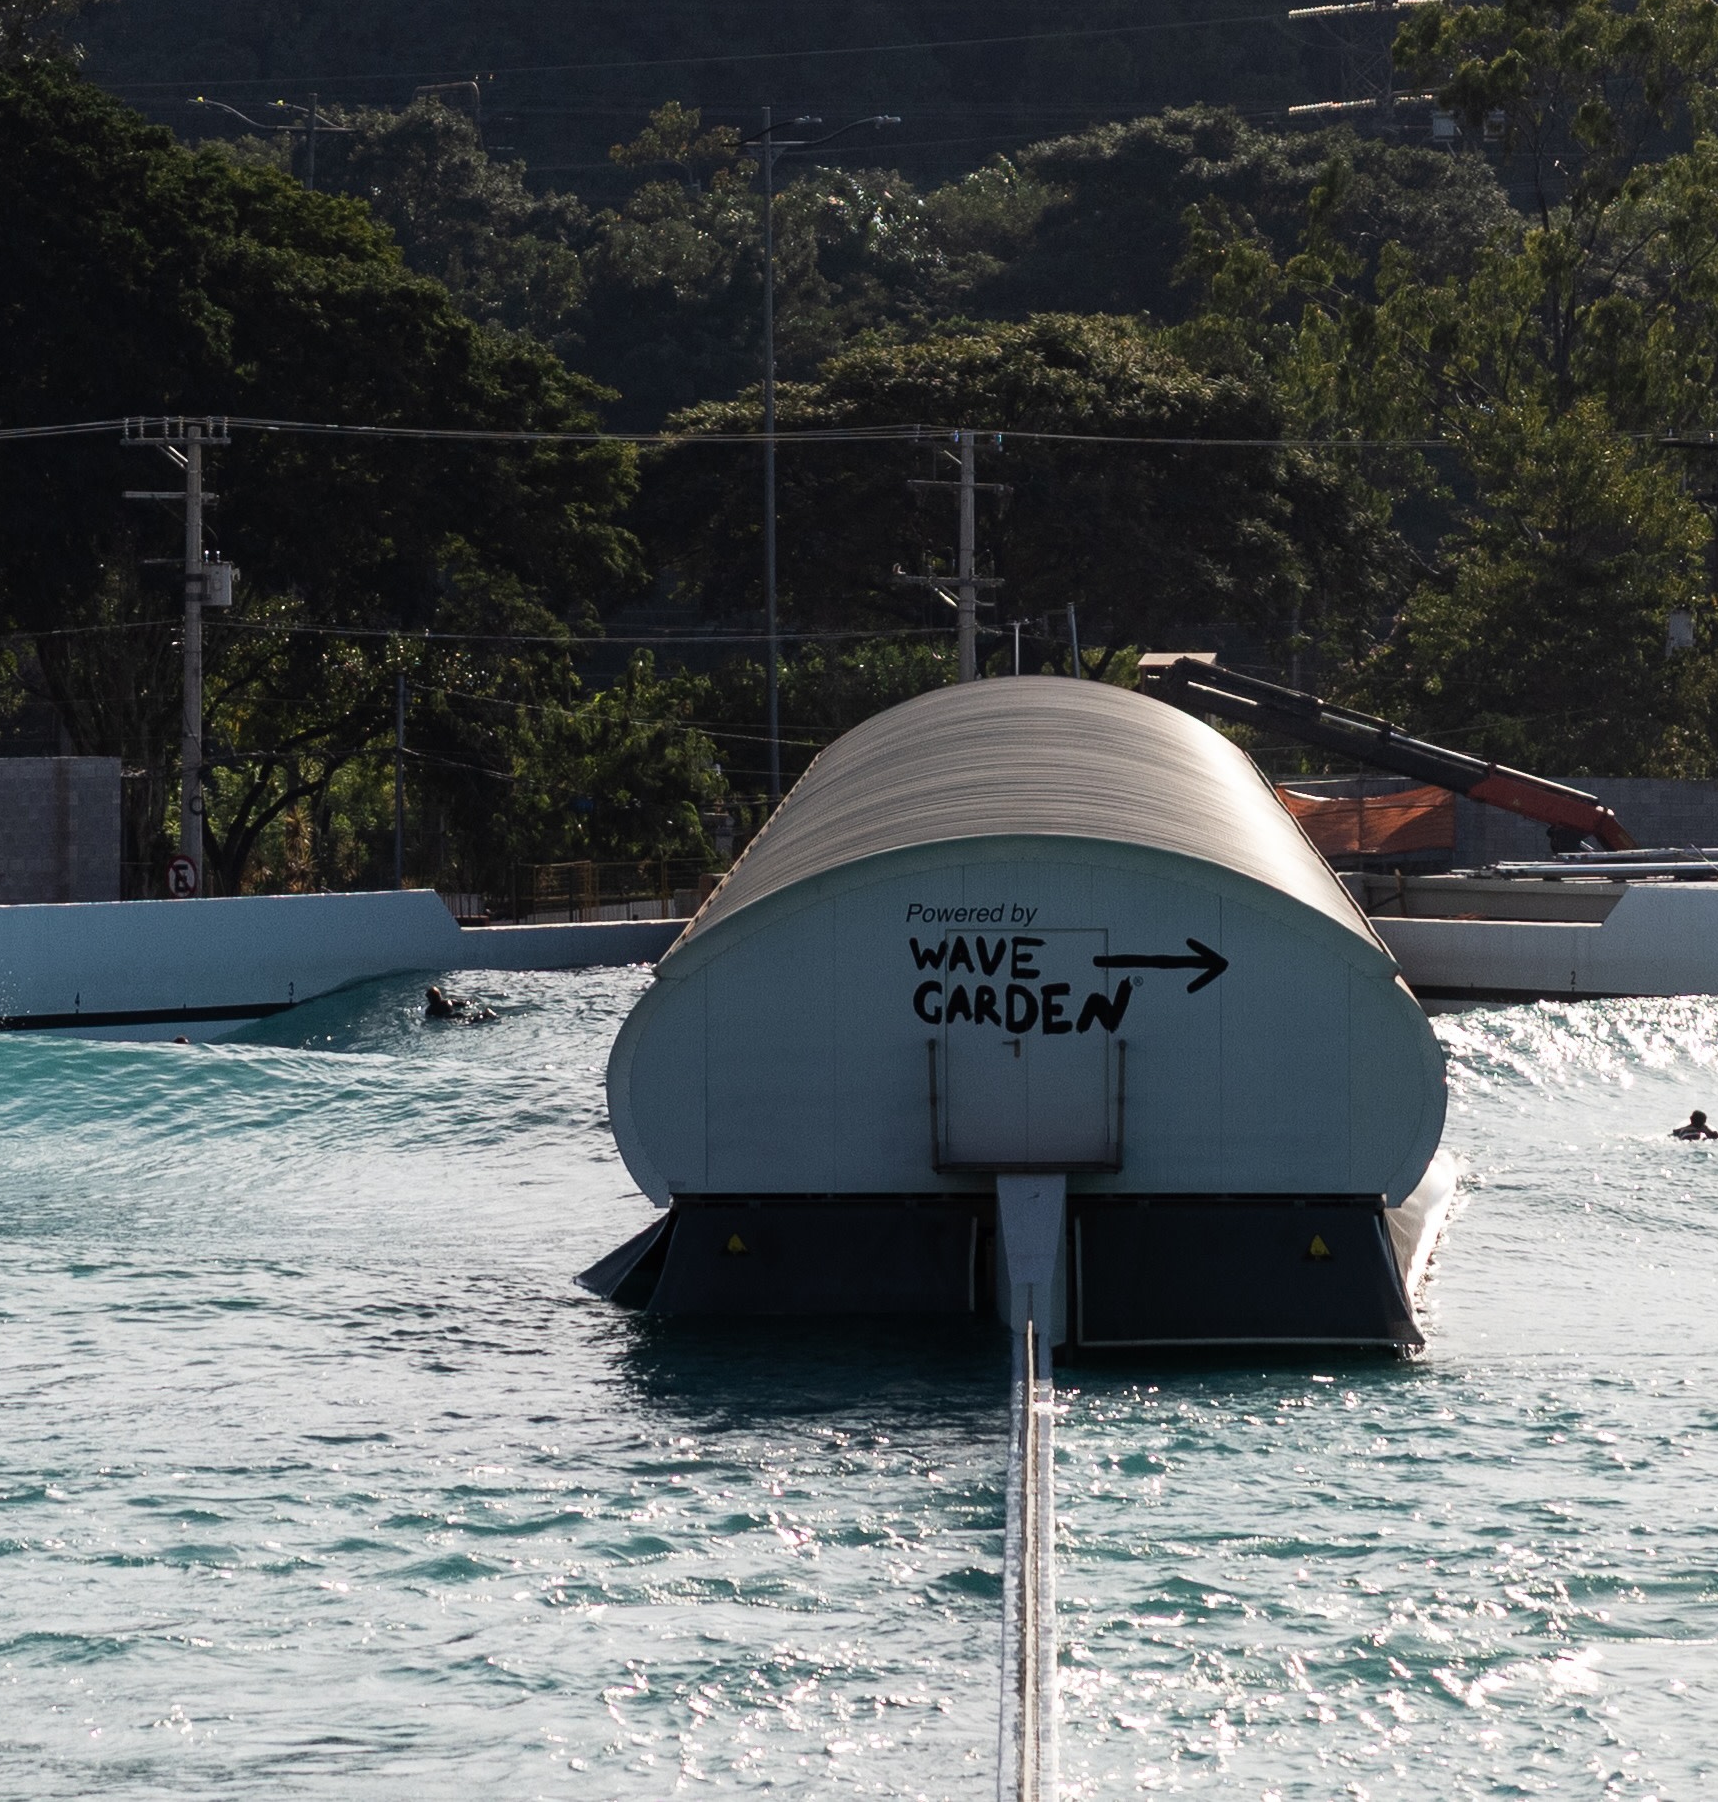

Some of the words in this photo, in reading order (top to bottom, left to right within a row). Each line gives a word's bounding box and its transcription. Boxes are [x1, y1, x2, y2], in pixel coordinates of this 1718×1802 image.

[905, 902, 1005, 924] Powered
[1010, 902, 1039, 927] by
[908, 935, 1047, 980] WAVE
[1570, 970, 1576, 985] 2
[288, 981, 294, 996] 3
